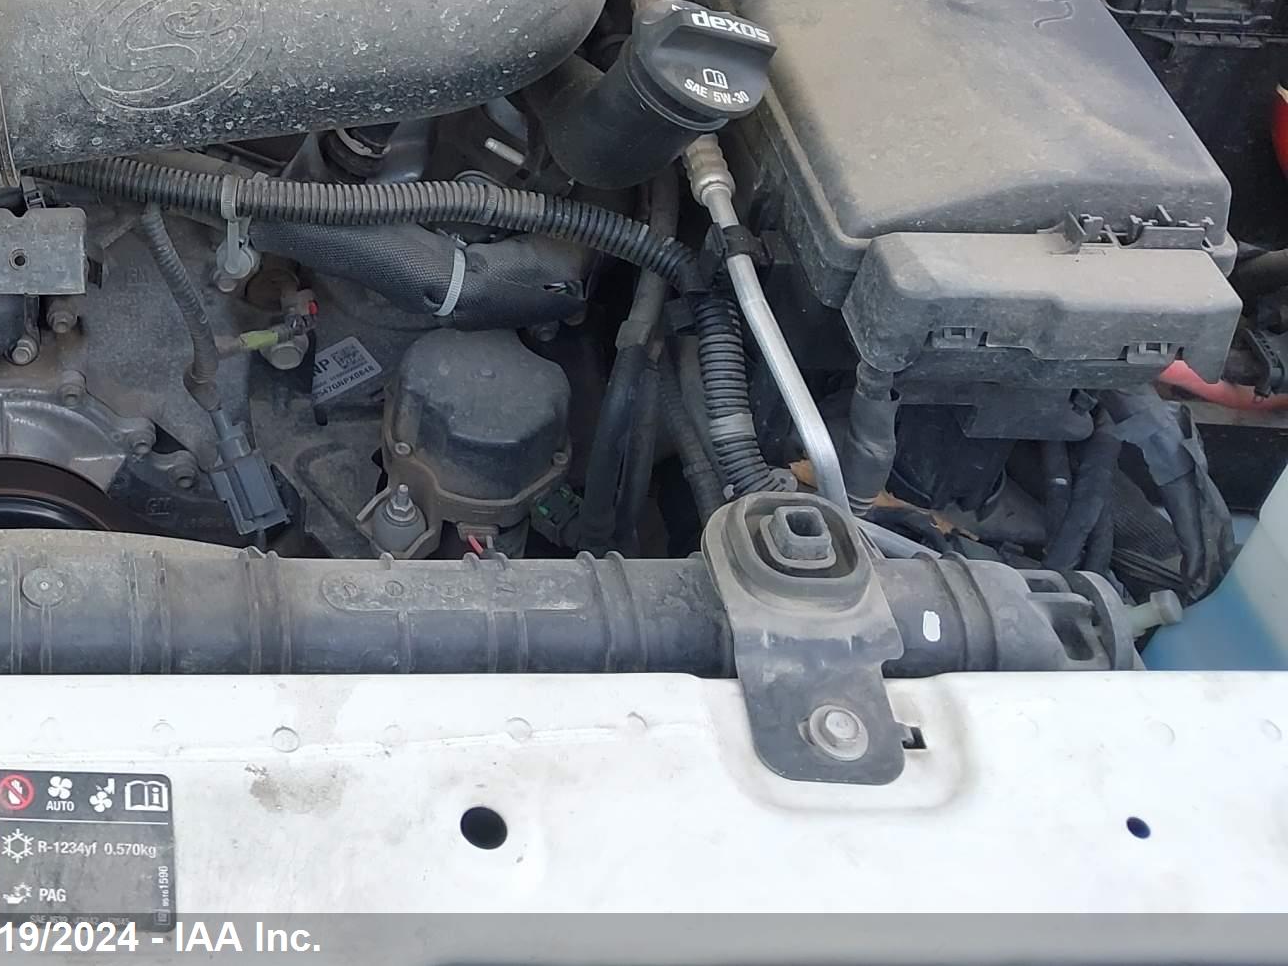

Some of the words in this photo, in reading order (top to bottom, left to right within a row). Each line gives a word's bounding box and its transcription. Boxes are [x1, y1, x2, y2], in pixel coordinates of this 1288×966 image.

[691, 10, 771, 43] dexos
[684, 78, 709, 99] SAE
[712, 90, 750, 105] 5W-30
[45, 800, 75, 812] AUTO
[37, 840, 98, 857] R-1234yf
[103, 842, 157, 859] 0.570kg
[39, 887, 67, 903] PAG
